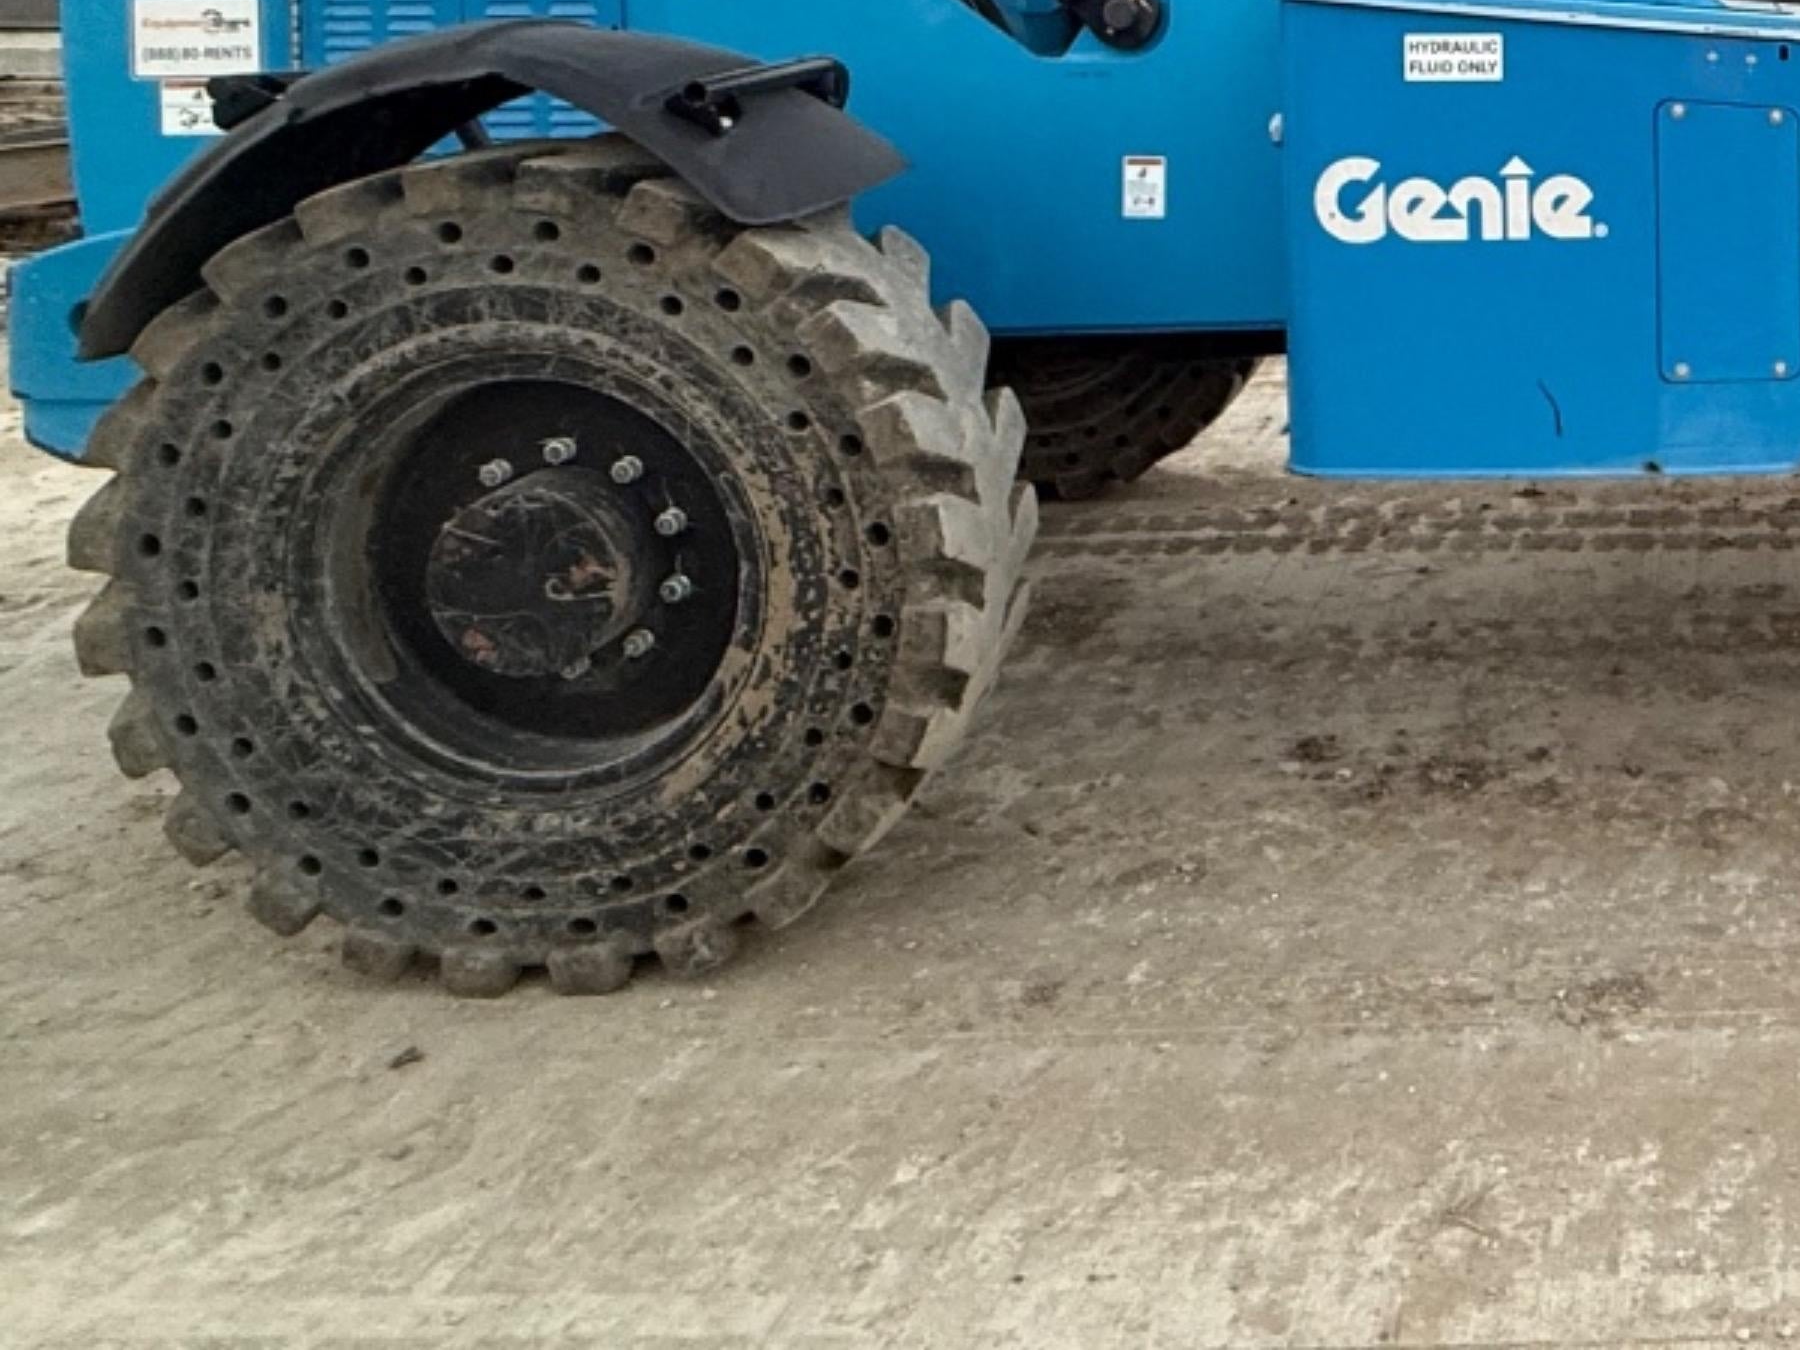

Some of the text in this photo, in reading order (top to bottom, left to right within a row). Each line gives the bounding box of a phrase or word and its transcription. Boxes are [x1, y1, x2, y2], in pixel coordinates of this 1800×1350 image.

[1409, 40, 1499, 54] HYDRAULIC
[1409, 59, 1498, 75] FLUID ONLY
